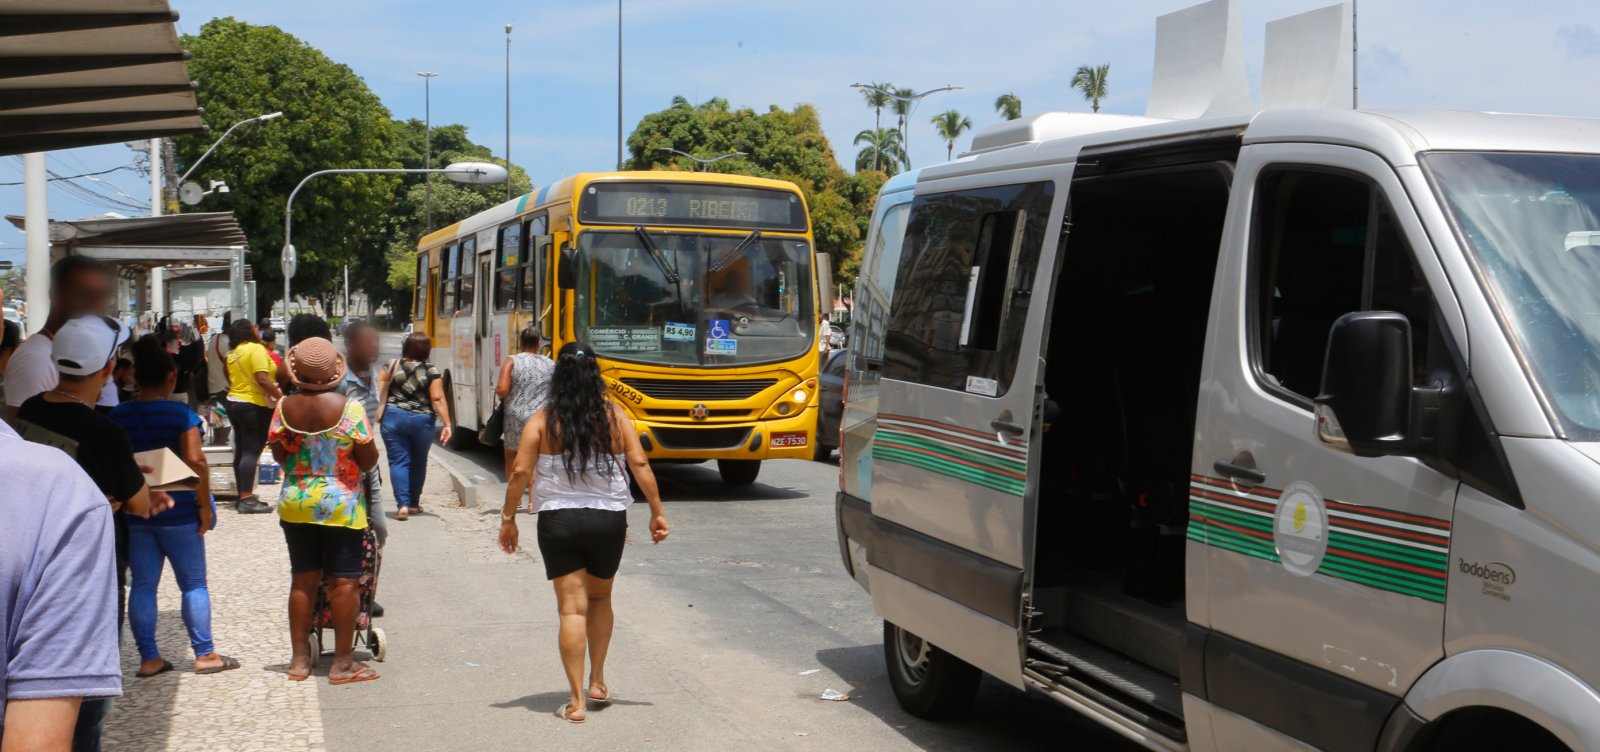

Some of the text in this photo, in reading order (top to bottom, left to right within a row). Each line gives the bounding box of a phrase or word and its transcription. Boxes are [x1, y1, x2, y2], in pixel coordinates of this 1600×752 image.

[628, 197, 760, 220] 0213 RIBEI
[666, 327, 676, 335] R$
[609, 380, 643, 405] 30293
[1458, 557, 1510, 585] Rodobens
